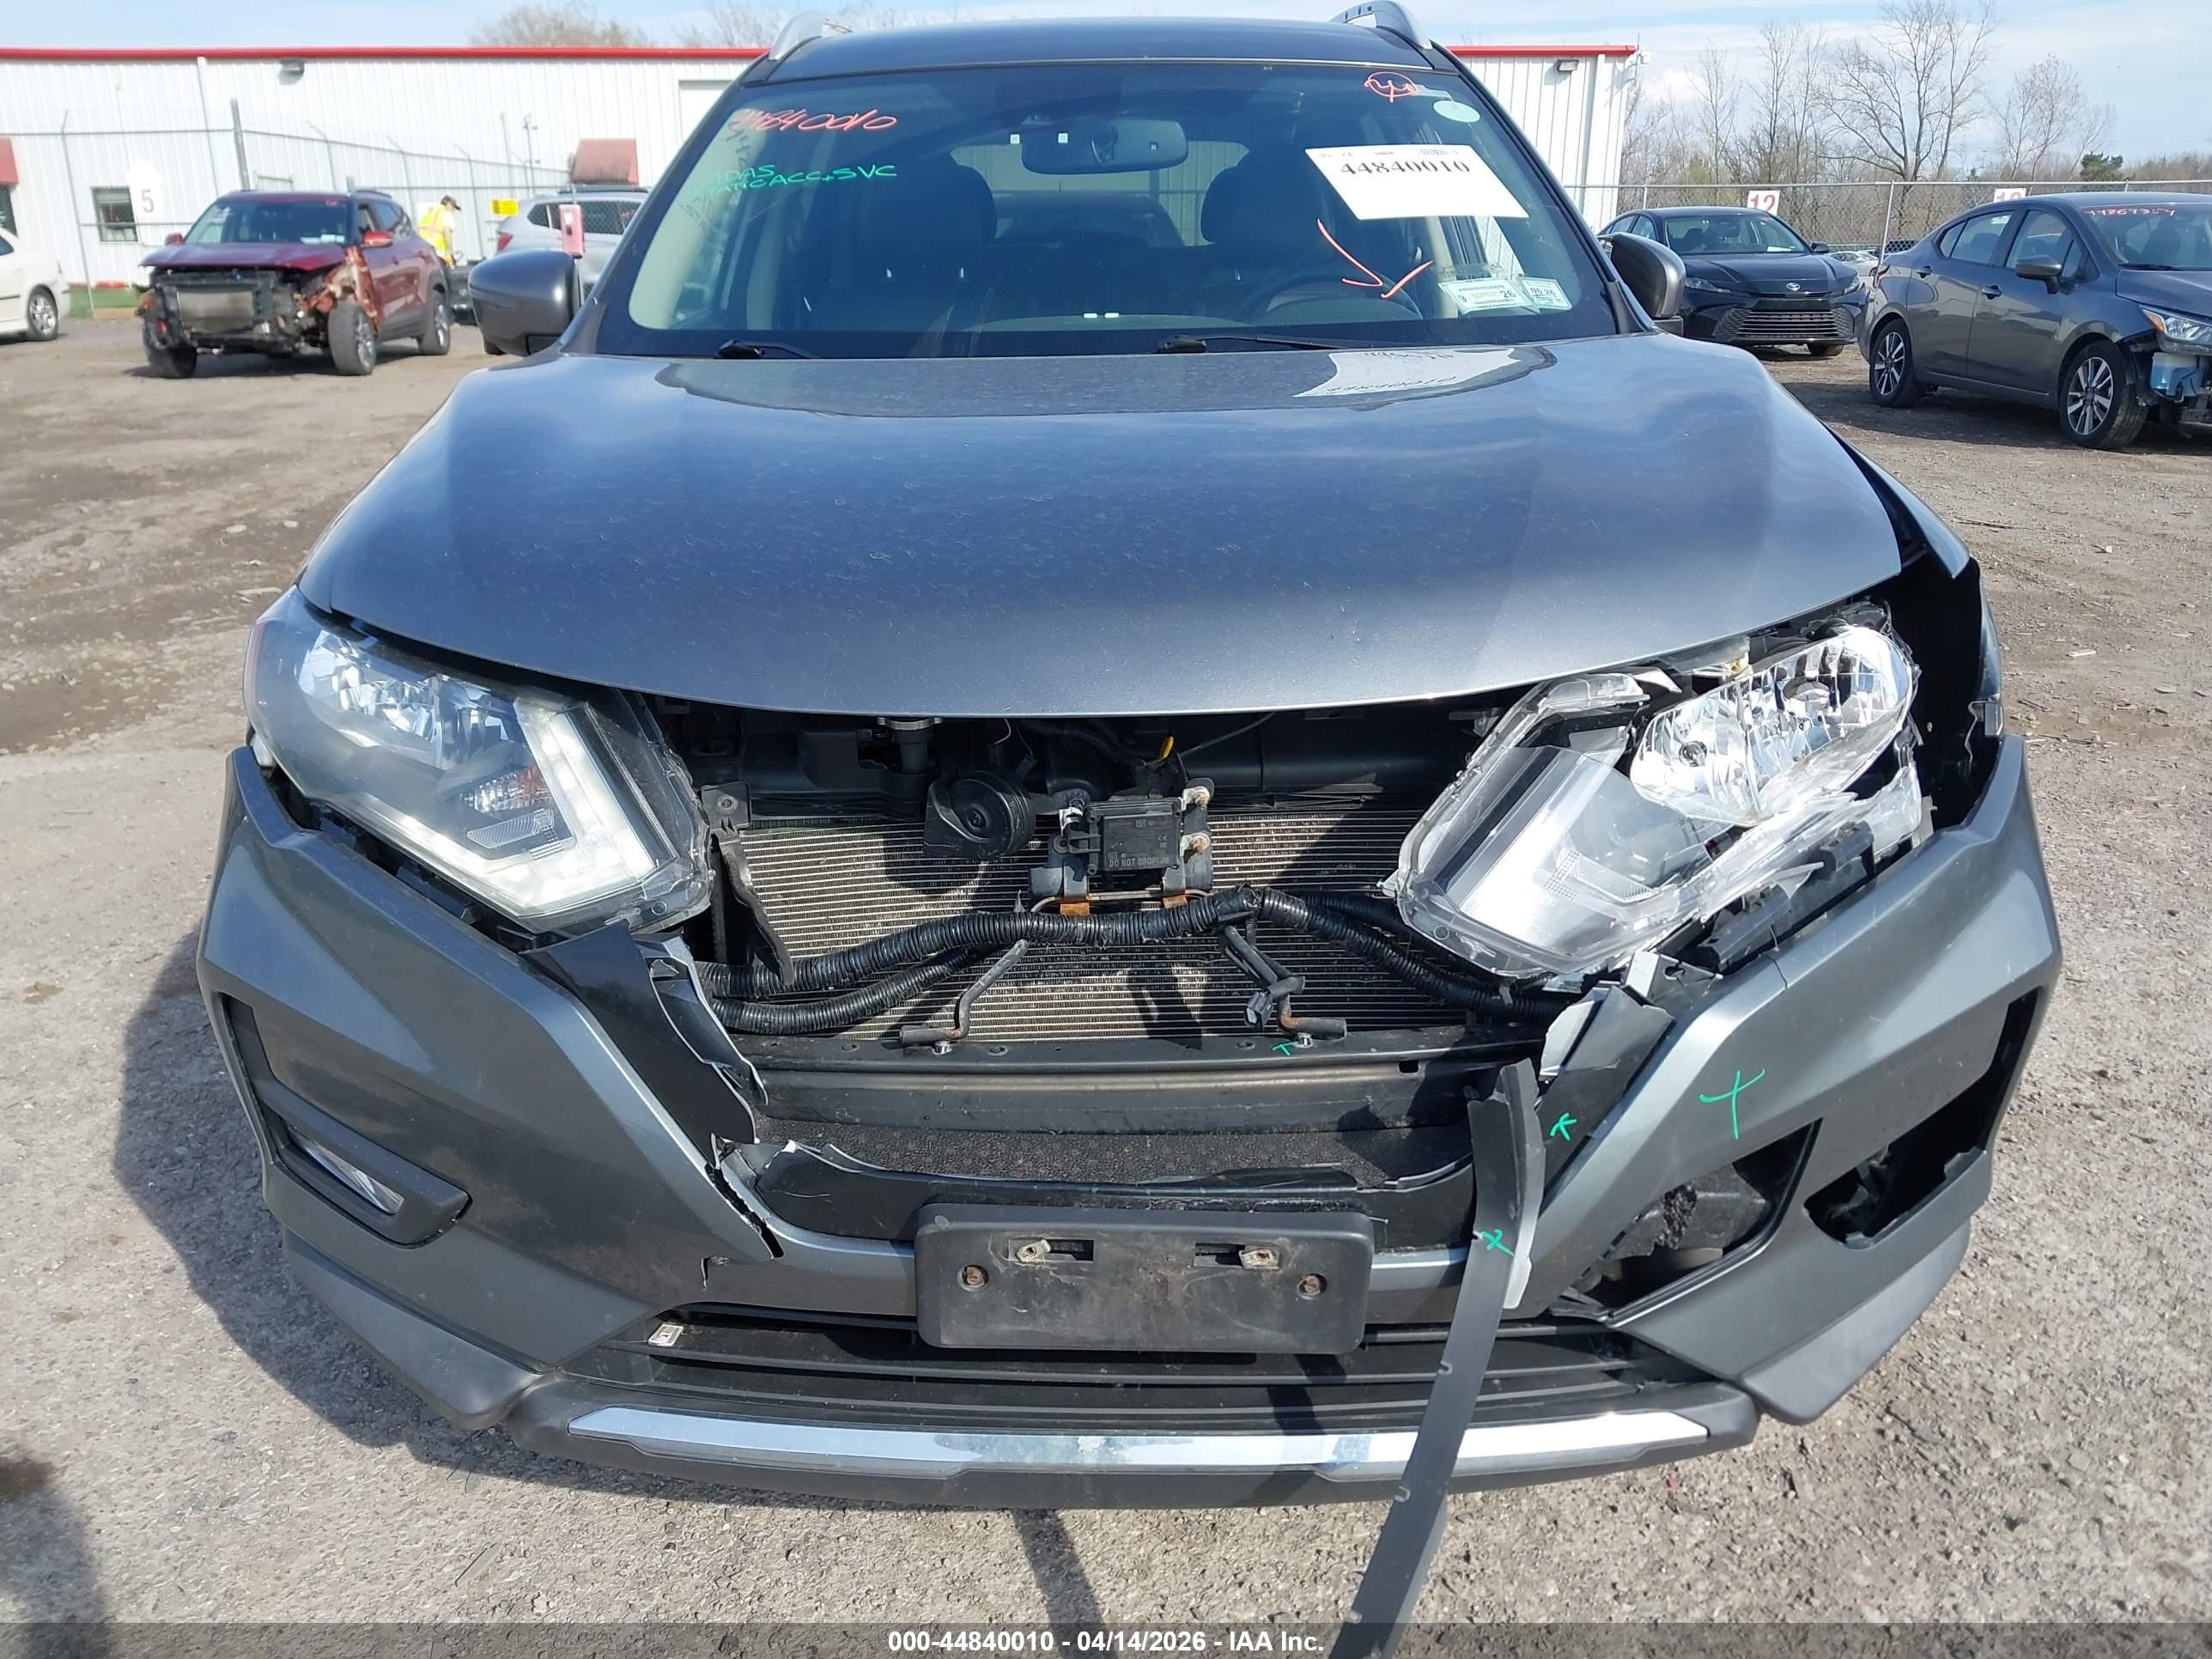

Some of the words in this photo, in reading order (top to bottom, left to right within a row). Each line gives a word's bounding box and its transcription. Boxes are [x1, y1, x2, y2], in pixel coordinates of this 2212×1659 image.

[1341, 160, 1469, 174] 44840010
[141, 189, 155, 213] 5
[1109, 860, 1120, 868] DO
[1121, 858, 1136, 867] NOT
